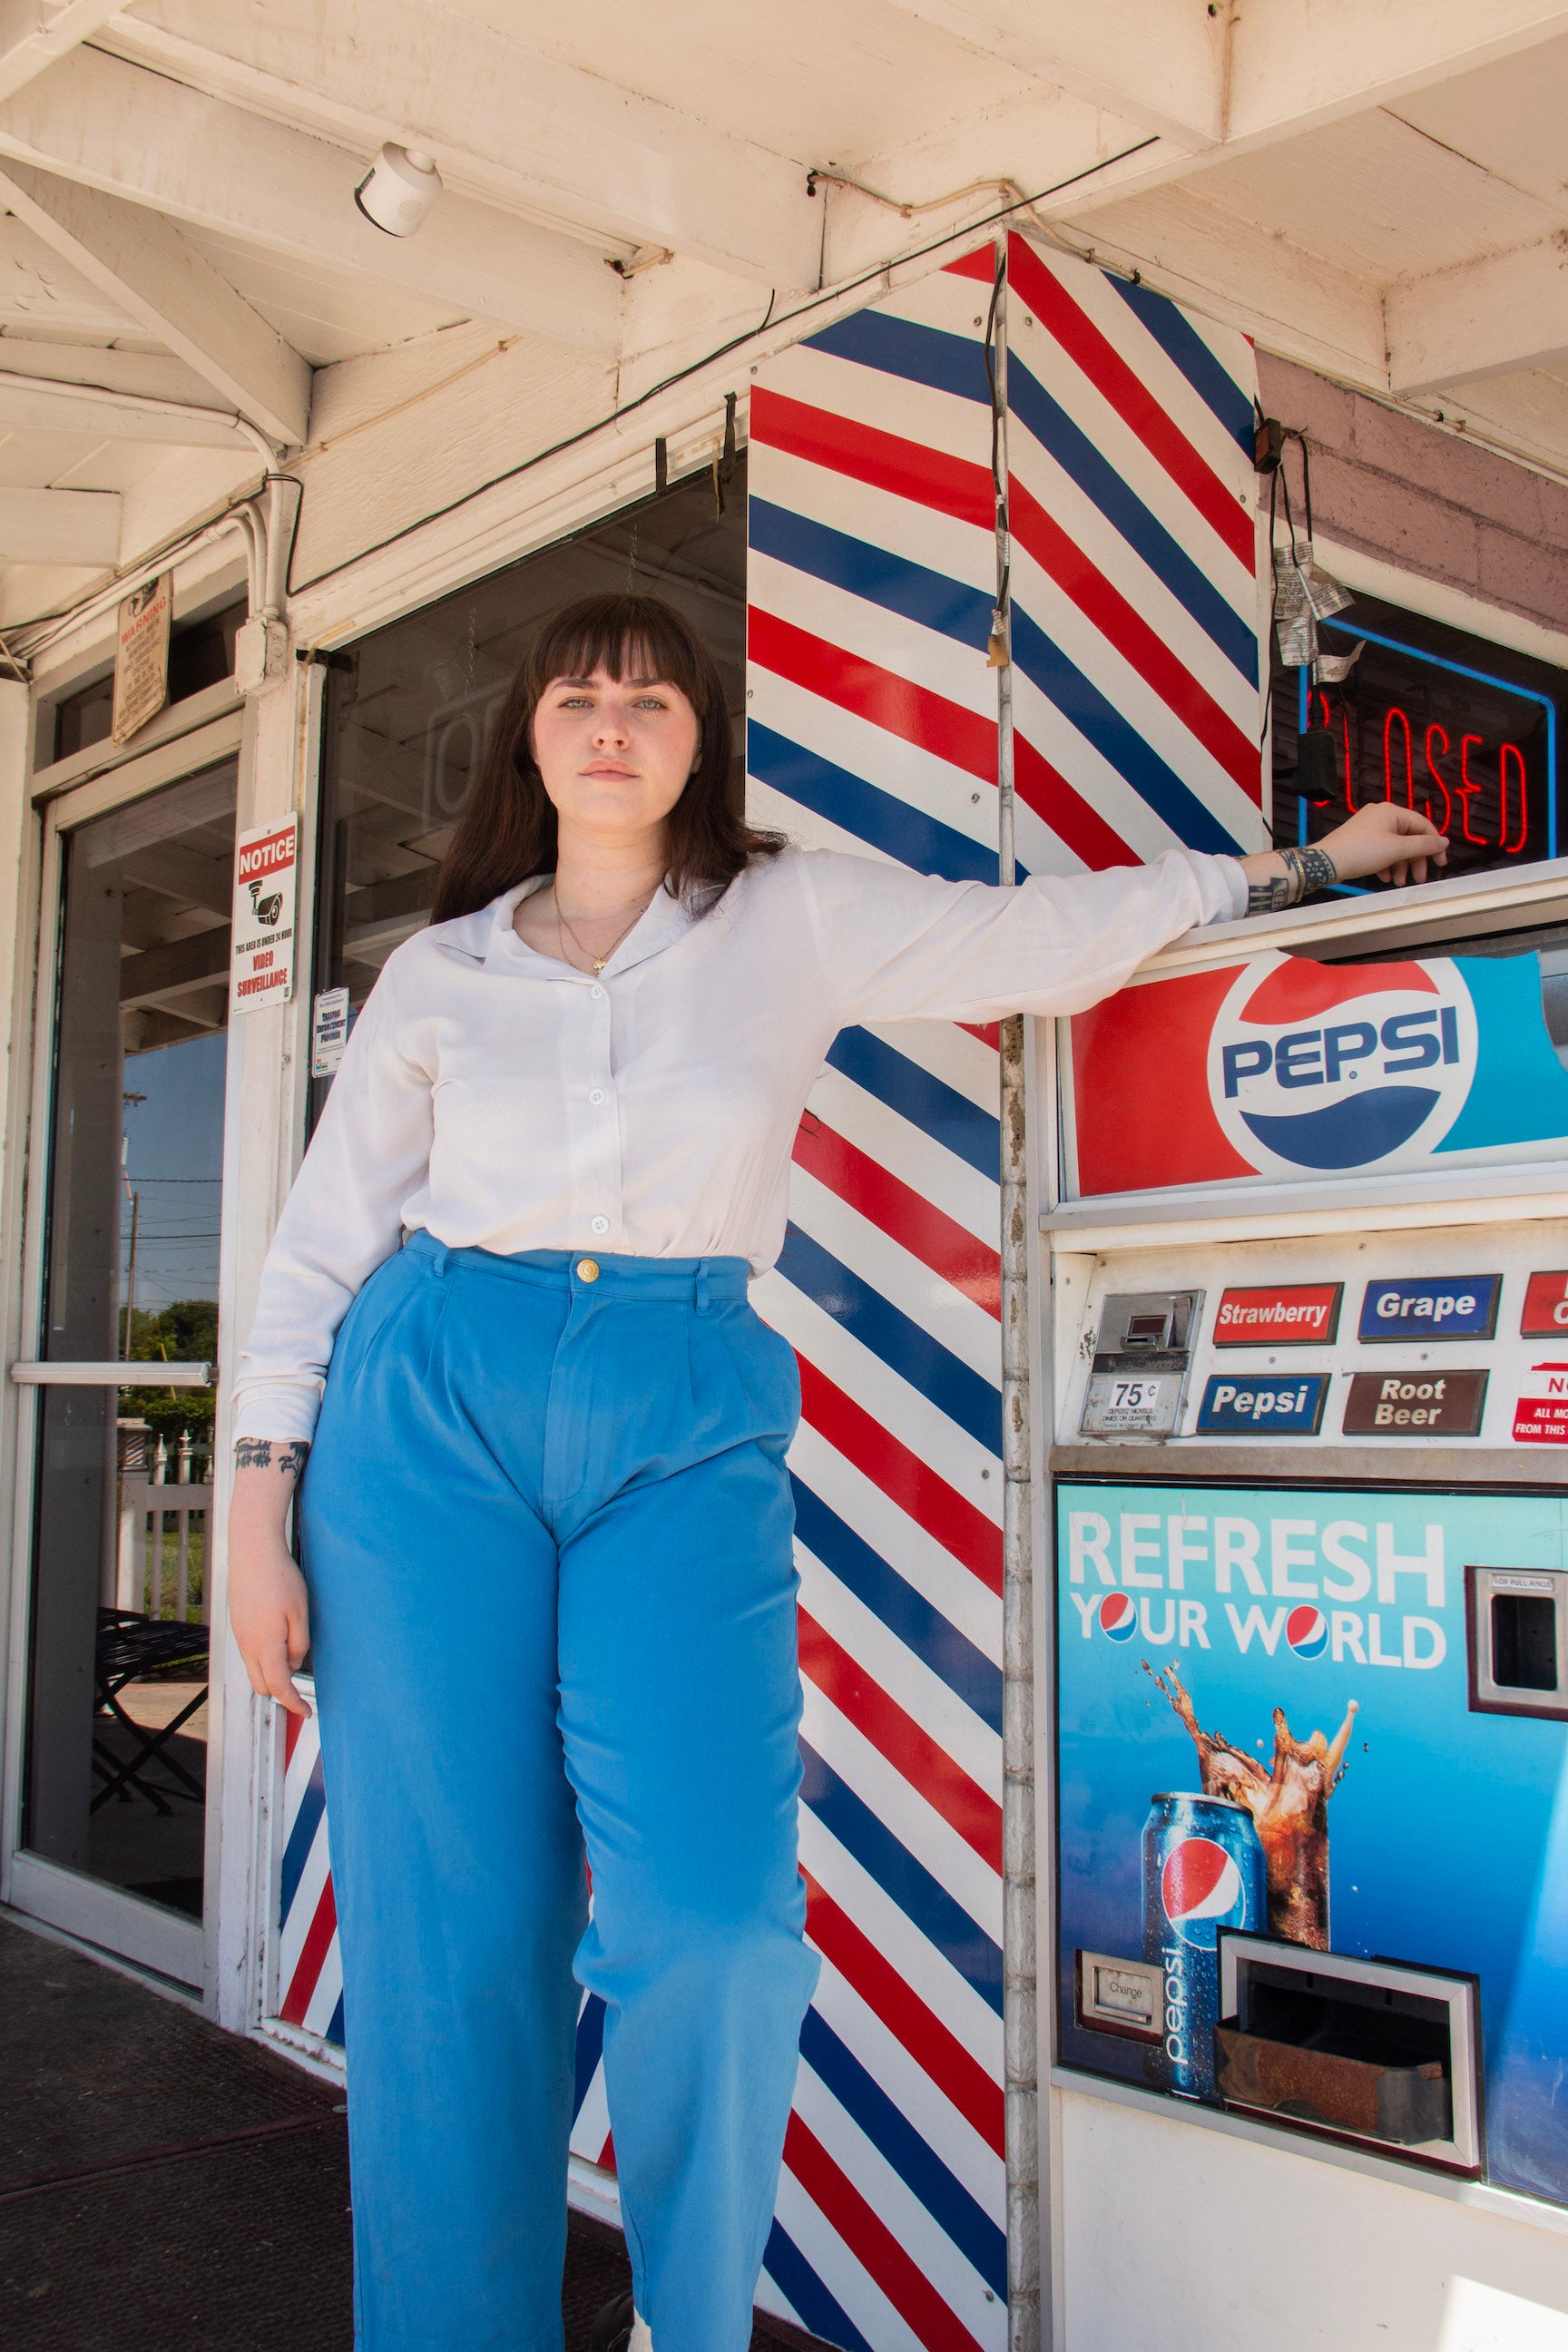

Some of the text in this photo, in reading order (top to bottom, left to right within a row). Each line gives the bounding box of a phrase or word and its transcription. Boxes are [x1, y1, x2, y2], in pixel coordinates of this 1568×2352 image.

[122, 596, 167, 644] WARNING
[240, 834, 295, 875] NOTICE
[235, 928, 292, 955] THIS AREA IS UNDER 24 HOUR
[253, 950, 274, 971] VIDEO
[238, 968, 288, 997] SURVEILLANCE
[1222, 1006, 1459, 1098] PEPSI
[1220, 1302, 1328, 1328] Strawberry
[1377, 1292, 1475, 1322] Grape
[1212, 1386, 1308, 1419] Pepsi
[1380, 1379, 1446, 1400] Root
[1375, 1404, 1441, 1425] Beer
[1534, 1407, 1551, 1418] ALL
[1515, 1423, 1565, 1436] FROM THIS
[1069, 1511, 1446, 1607] REFRESH
[1070, 1591, 1446, 1669] YOUR WORLD
[1110, 1982, 1142, 1999] Change
[1161, 1946, 1189, 2065] pepsi
